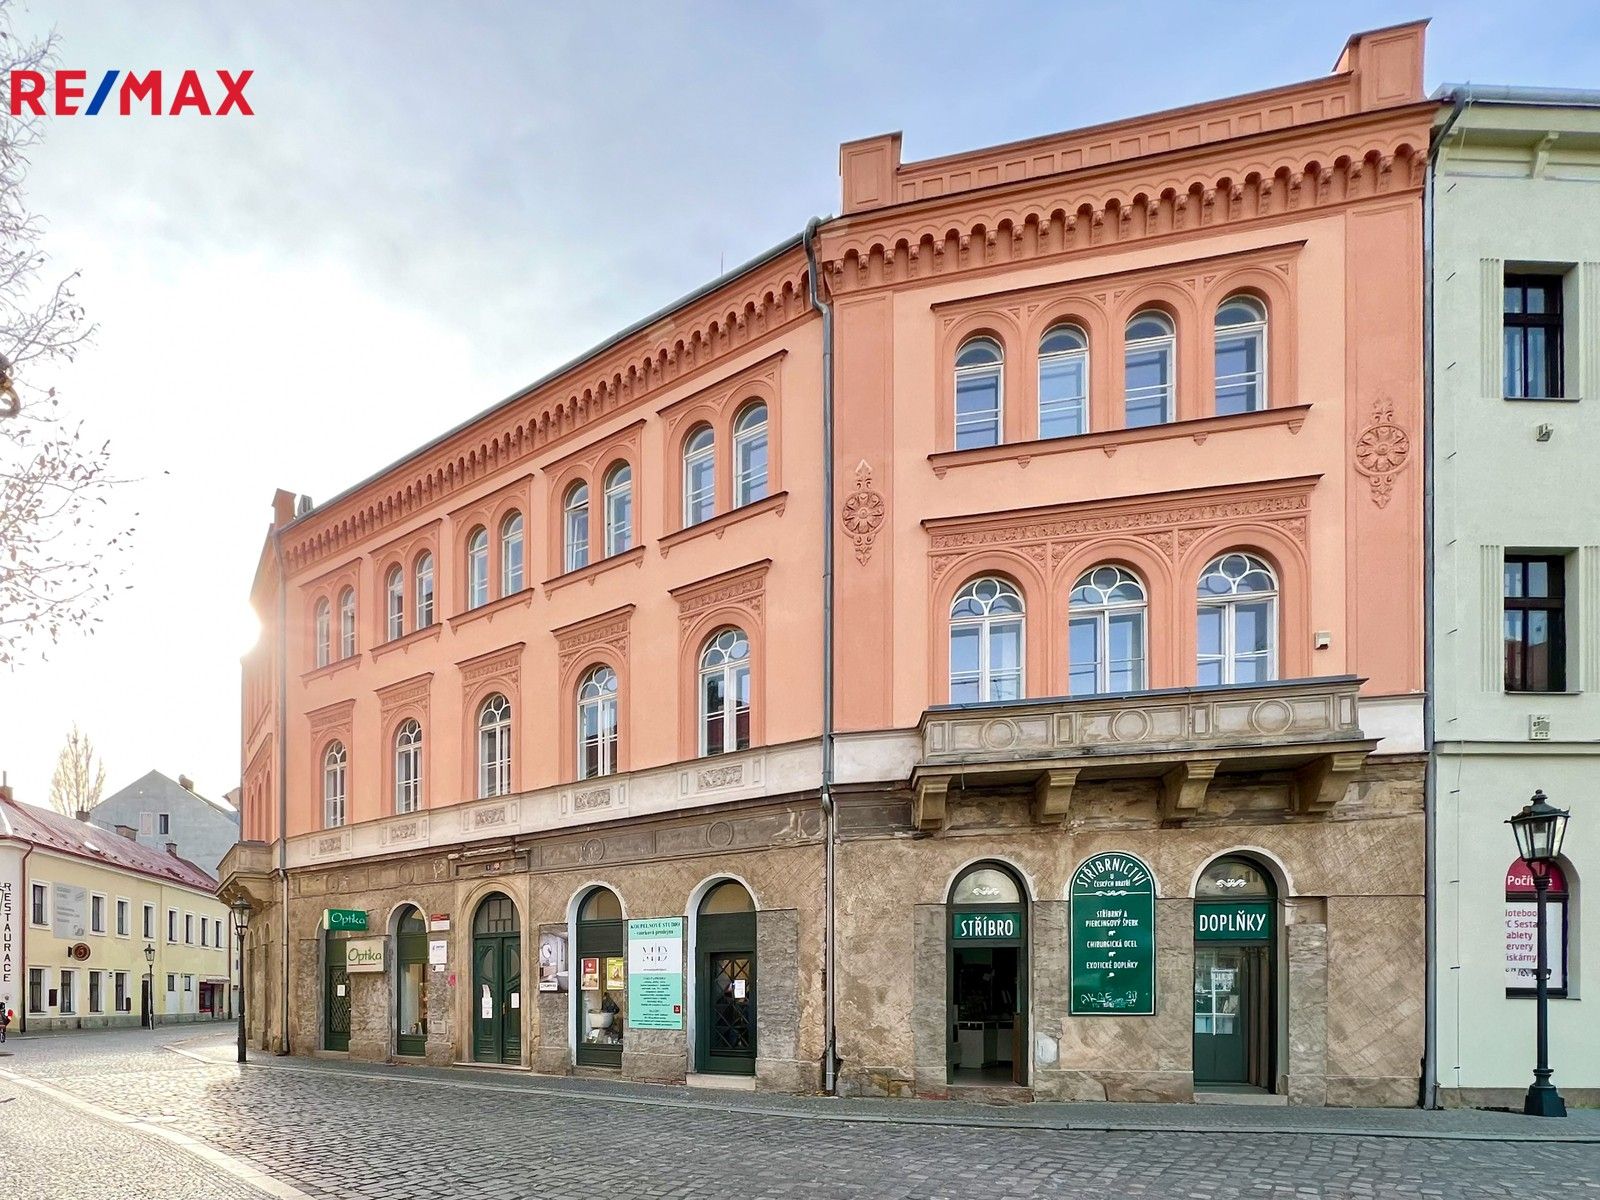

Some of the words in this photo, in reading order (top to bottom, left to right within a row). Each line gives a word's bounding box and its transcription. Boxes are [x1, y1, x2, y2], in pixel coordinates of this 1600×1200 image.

[1076, 858, 1151, 888] STŘÍBRNICTVÍ
[1507, 875, 1553, 886] Počíte
[1123, 910, 1128, 918] A
[1505, 909, 1538, 917] oteboo
[331, 912, 366, 926] Optika
[1199, 910, 1267, 932] DOPLŇKY
[1514, 920, 1538, 928] Sesta
[961, 916, 1014, 937] STŘÍBRO
[3, 883, 12, 982] RESTAURACE
[1506, 931, 1533, 941] ablety
[1123, 940, 1138, 948] OCEL
[1506, 944, 1534, 952] ervery
[348, 946, 382, 964] Optika
[1506, 953, 1537, 962] iskárny
[1086, 960, 1112, 969] EXOTICKÉ
[1113, 960, 1139, 969] DOPLŇKY
